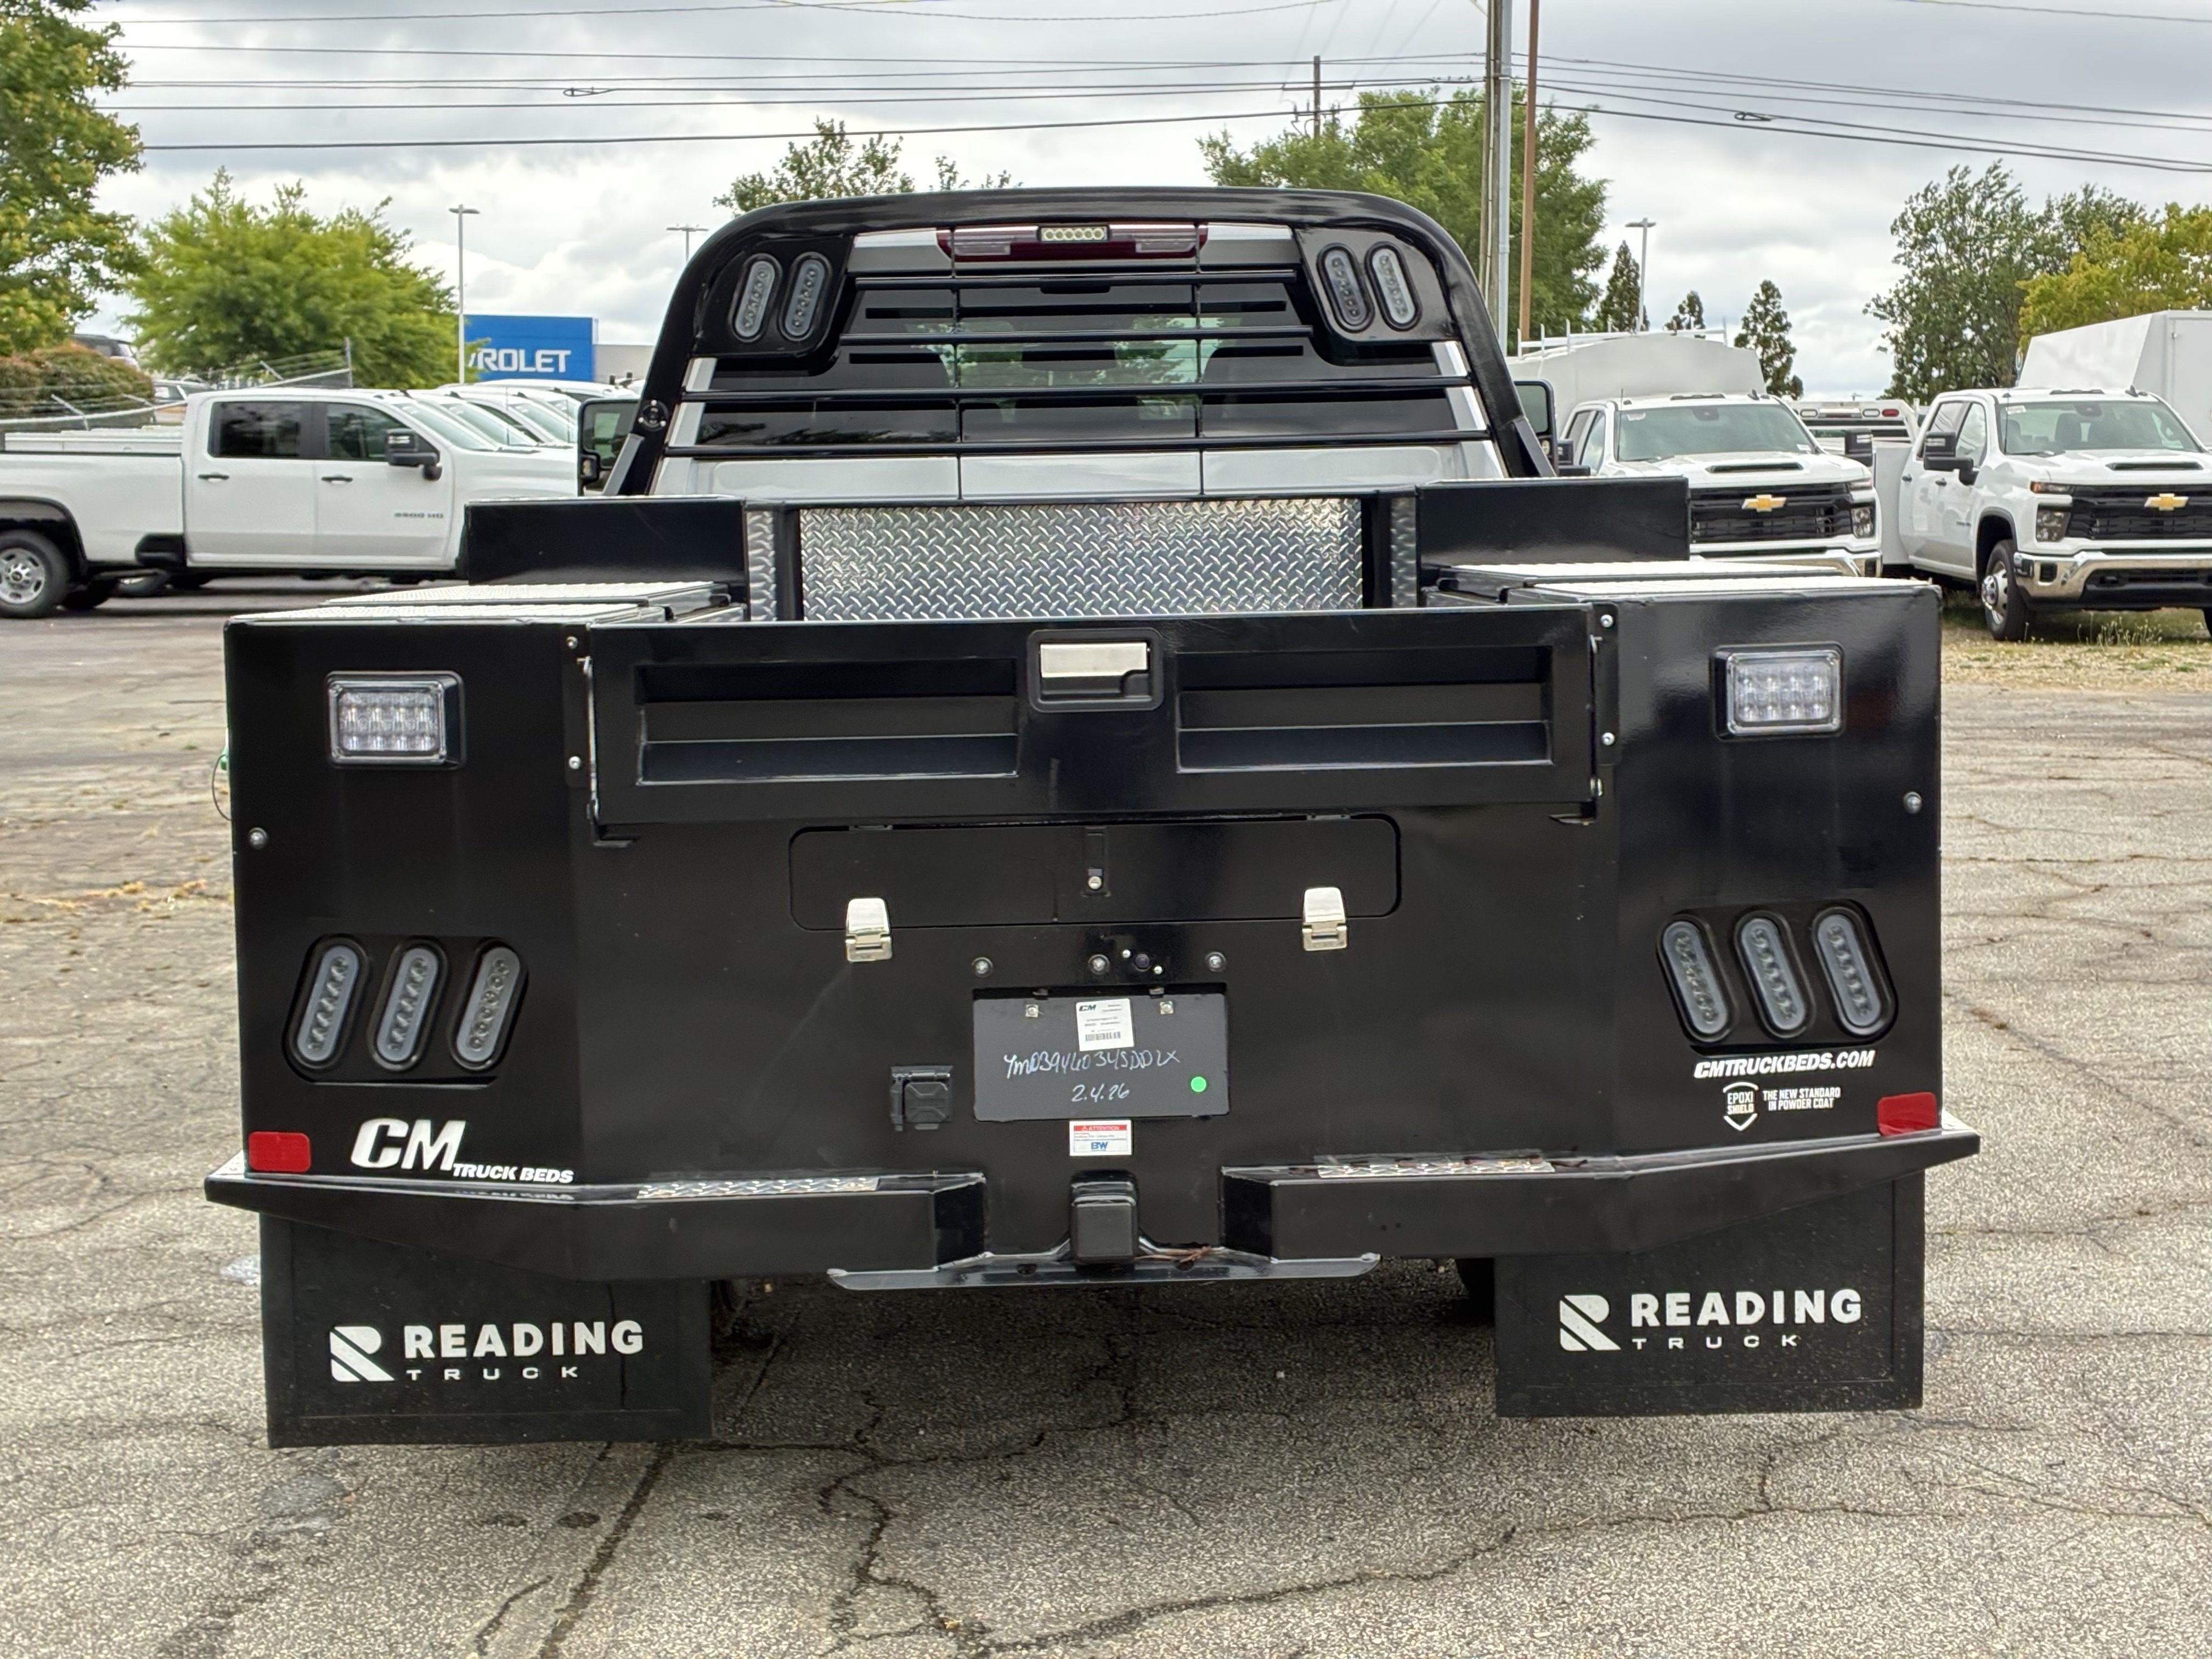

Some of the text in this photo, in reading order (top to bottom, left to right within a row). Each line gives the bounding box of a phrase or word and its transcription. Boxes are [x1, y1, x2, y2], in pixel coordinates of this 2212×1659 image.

[467, 348, 572, 373] ROLET
[1694, 1050, 1876, 1079] CMTRUCKBEDS.COM
[1728, 1091, 1753, 1104] EPOXI
[1763, 1087, 1841, 1101] THE NEW STANDARD
[1728, 1103, 1754, 1115] SHIELD
[1768, 1097, 1835, 1111] IN POWDER COAT
[351, 1118, 466, 1171] CM
[453, 1164, 575, 1184] TRUCK BEDS
[1631, 1289, 1861, 1327] READING
[404, 1320, 643, 1359] READING
[1632, 1334, 1797, 1350] TRUCK
[406, 1367, 578, 1380] TRUCK
